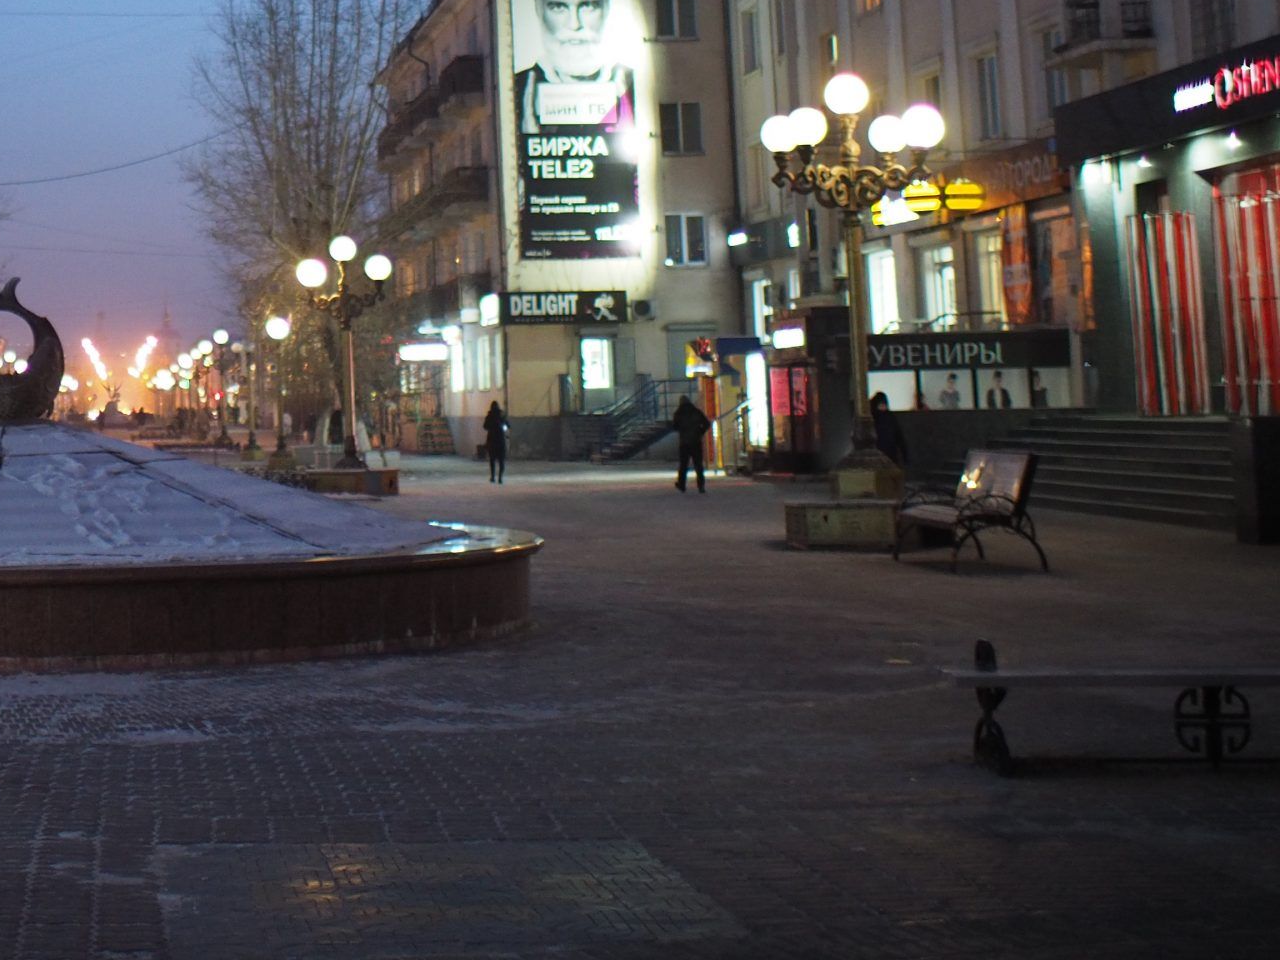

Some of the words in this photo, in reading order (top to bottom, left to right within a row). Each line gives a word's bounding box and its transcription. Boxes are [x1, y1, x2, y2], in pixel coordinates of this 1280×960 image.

[527, 135, 609, 157] БИРЖА
[527, 158, 594, 180] TELE2
[510, 294, 579, 316] DELIGHT
[869, 341, 1005, 368] УВЕНИРЫ
